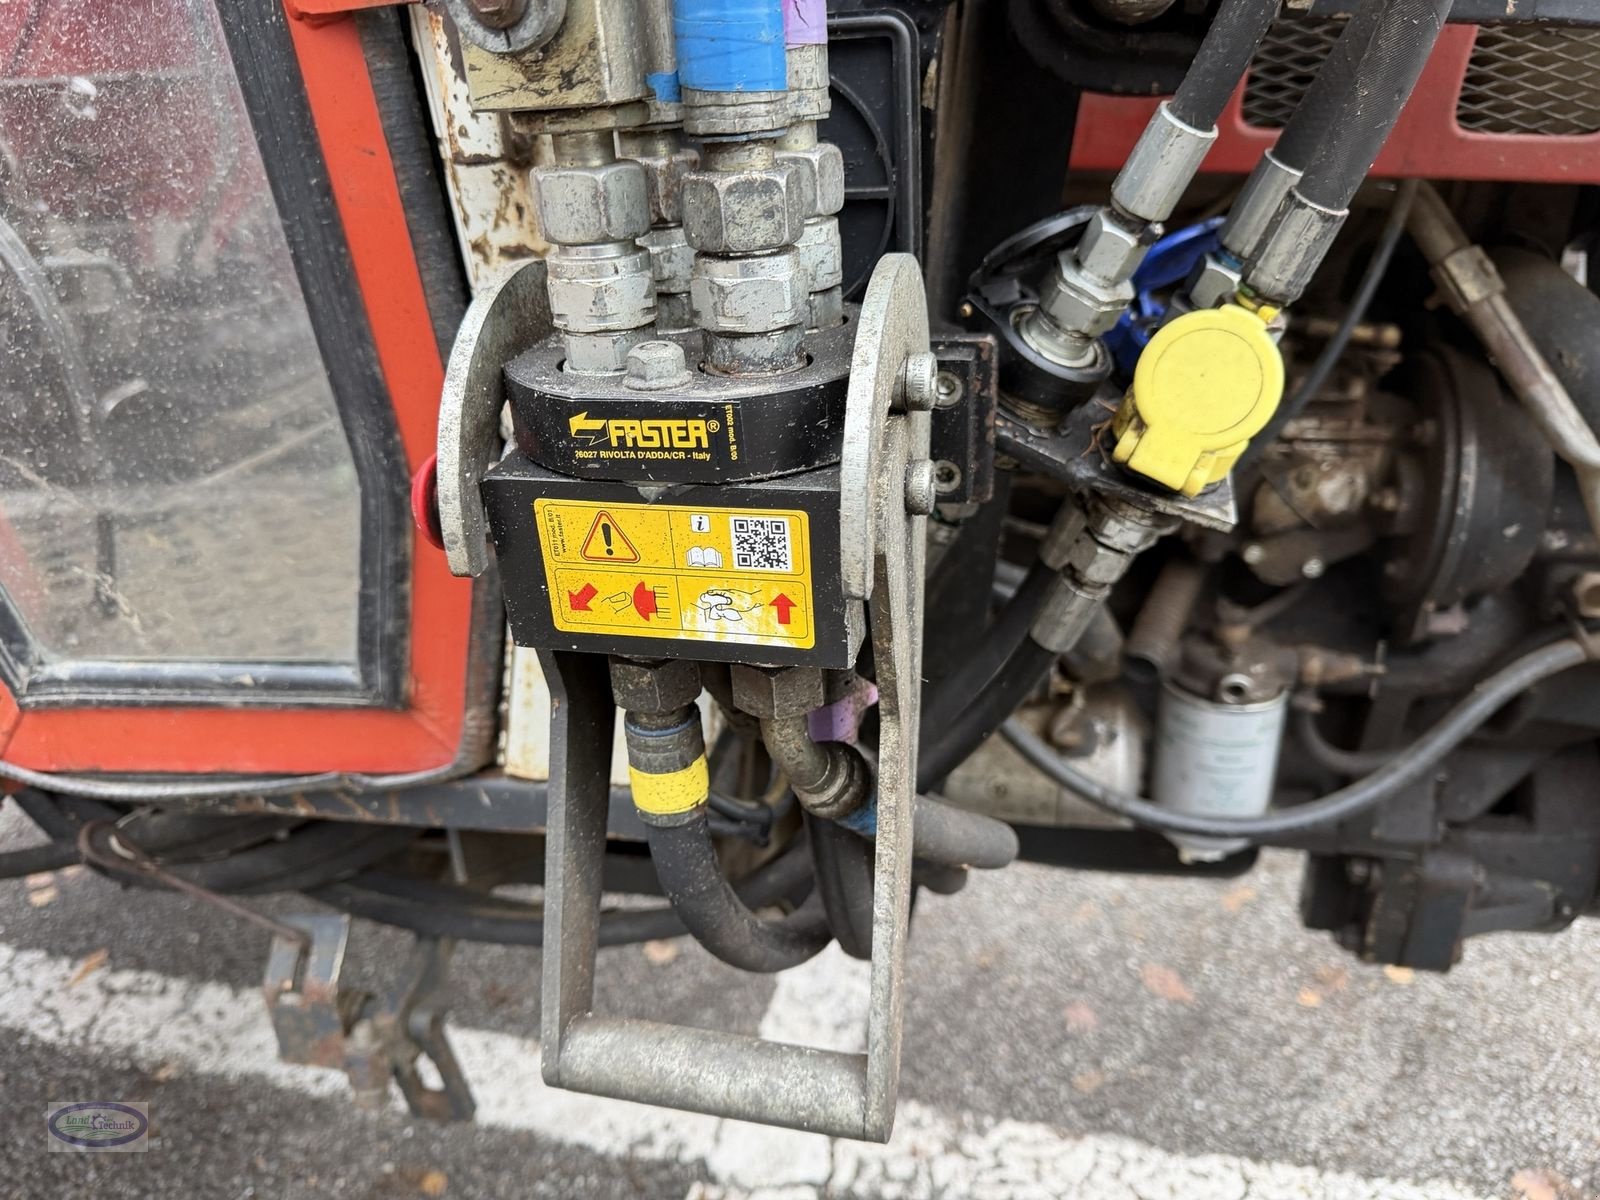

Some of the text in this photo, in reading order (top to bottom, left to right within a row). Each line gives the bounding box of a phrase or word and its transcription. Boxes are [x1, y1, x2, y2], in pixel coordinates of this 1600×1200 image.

[575, 450, 597, 460] 26027
[600, 450, 636, 459] RIVOLTA
[637, 451, 686, 460] D'ADDA/CR
[692, 451, 711, 461] Italy
